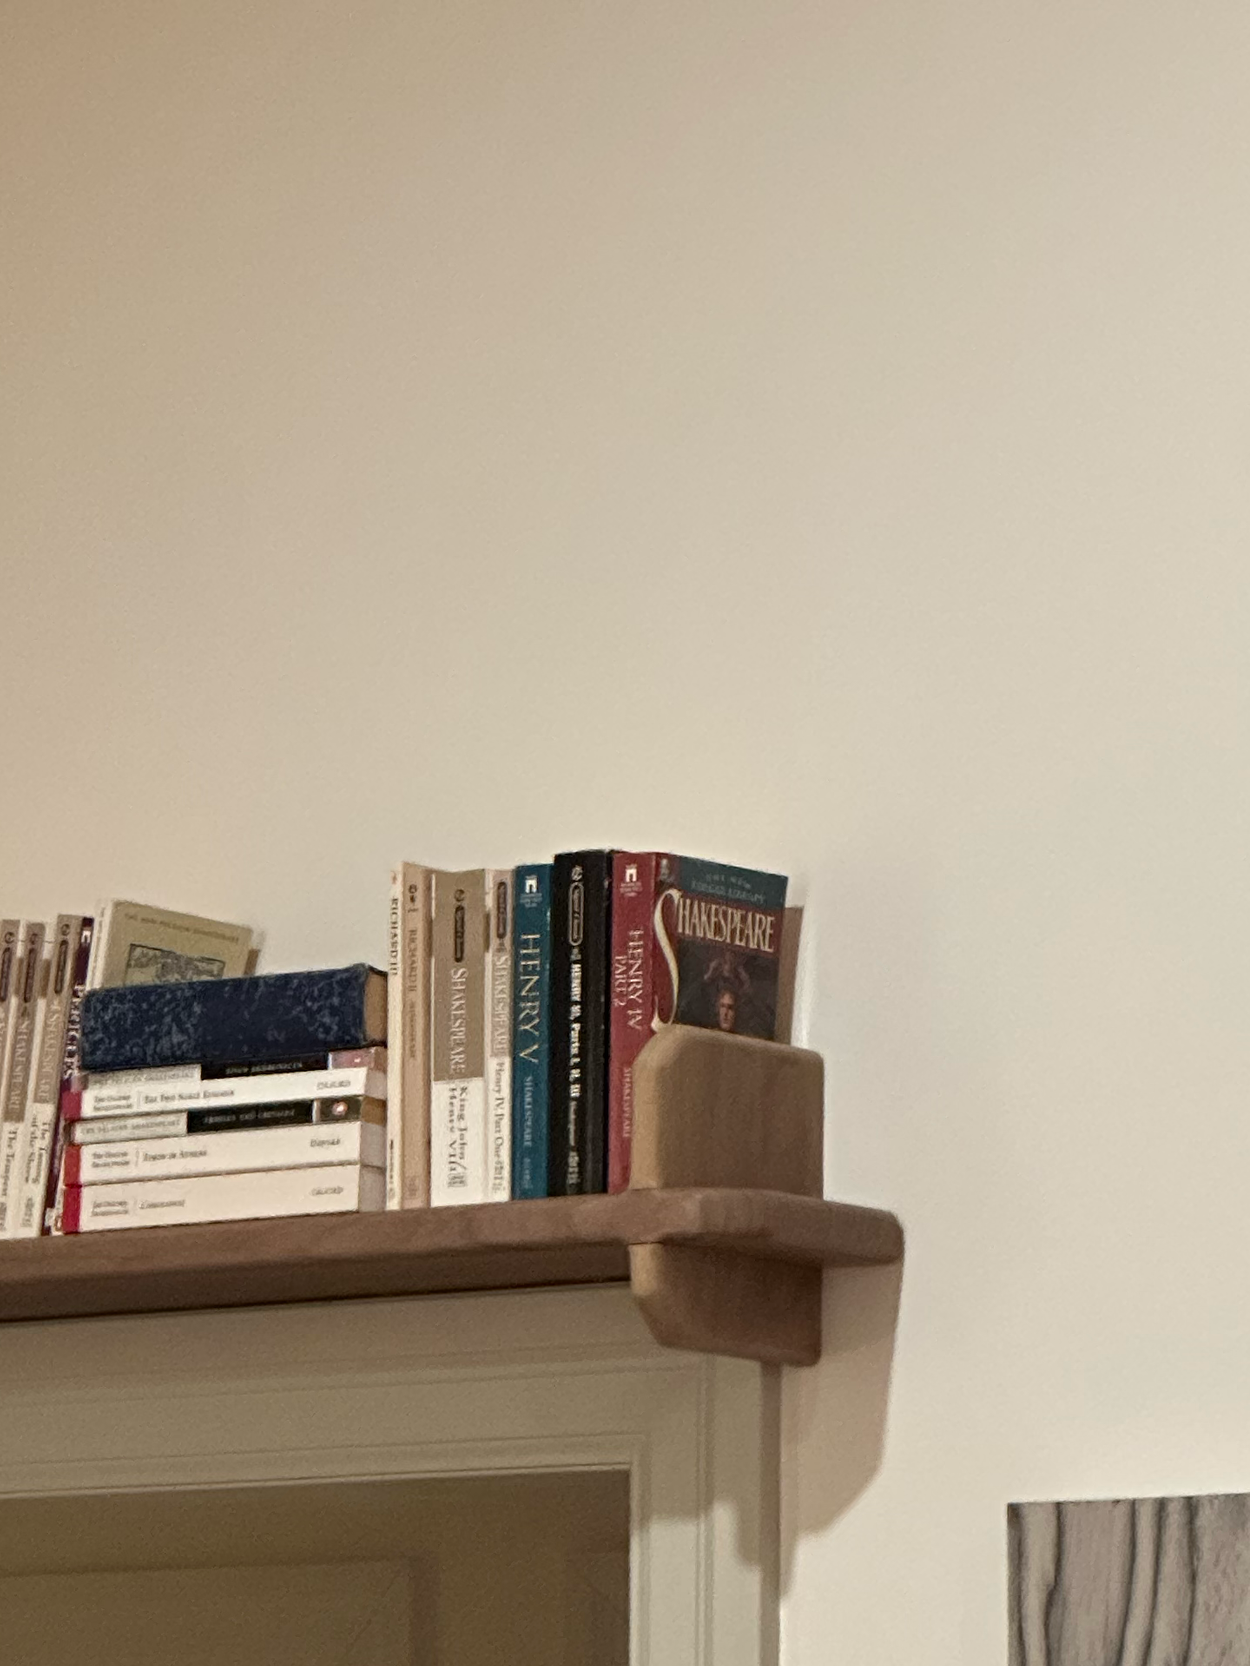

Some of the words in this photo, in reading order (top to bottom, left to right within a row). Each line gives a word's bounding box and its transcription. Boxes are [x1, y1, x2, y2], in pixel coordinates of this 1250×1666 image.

[389, 897, 399, 961] RICHARD
[407, 928, 417, 982] RICHARD
[614, 954, 627, 994] PART
[627, 929, 644, 1004] HENRY
[652, 888, 776, 1033] SHAKESPEARE
[494, 953, 512, 1057] SHAKESPEARE
[519, 933, 541, 1038] HENRY
[570, 963, 582, 1002] HENRY
[613, 997, 627, 1008] 2
[63, 984, 86, 1081] PERICLES
[449, 967, 469, 1075] SHAKESPEARE
[626, 1009, 644, 1031] IV
[518, 1043, 540, 1064] V
[492, 1062, 505, 1094] Henry
[457, 1085, 468, 1121] King
[493, 1114, 505, 1133] Part
[522, 1075, 534, 1148] SHAKESPEARE
[622, 1066, 633, 1138] SHAKESPEARE
[7, 1130, 17, 1149] The
[493, 1136, 505, 1158] One
